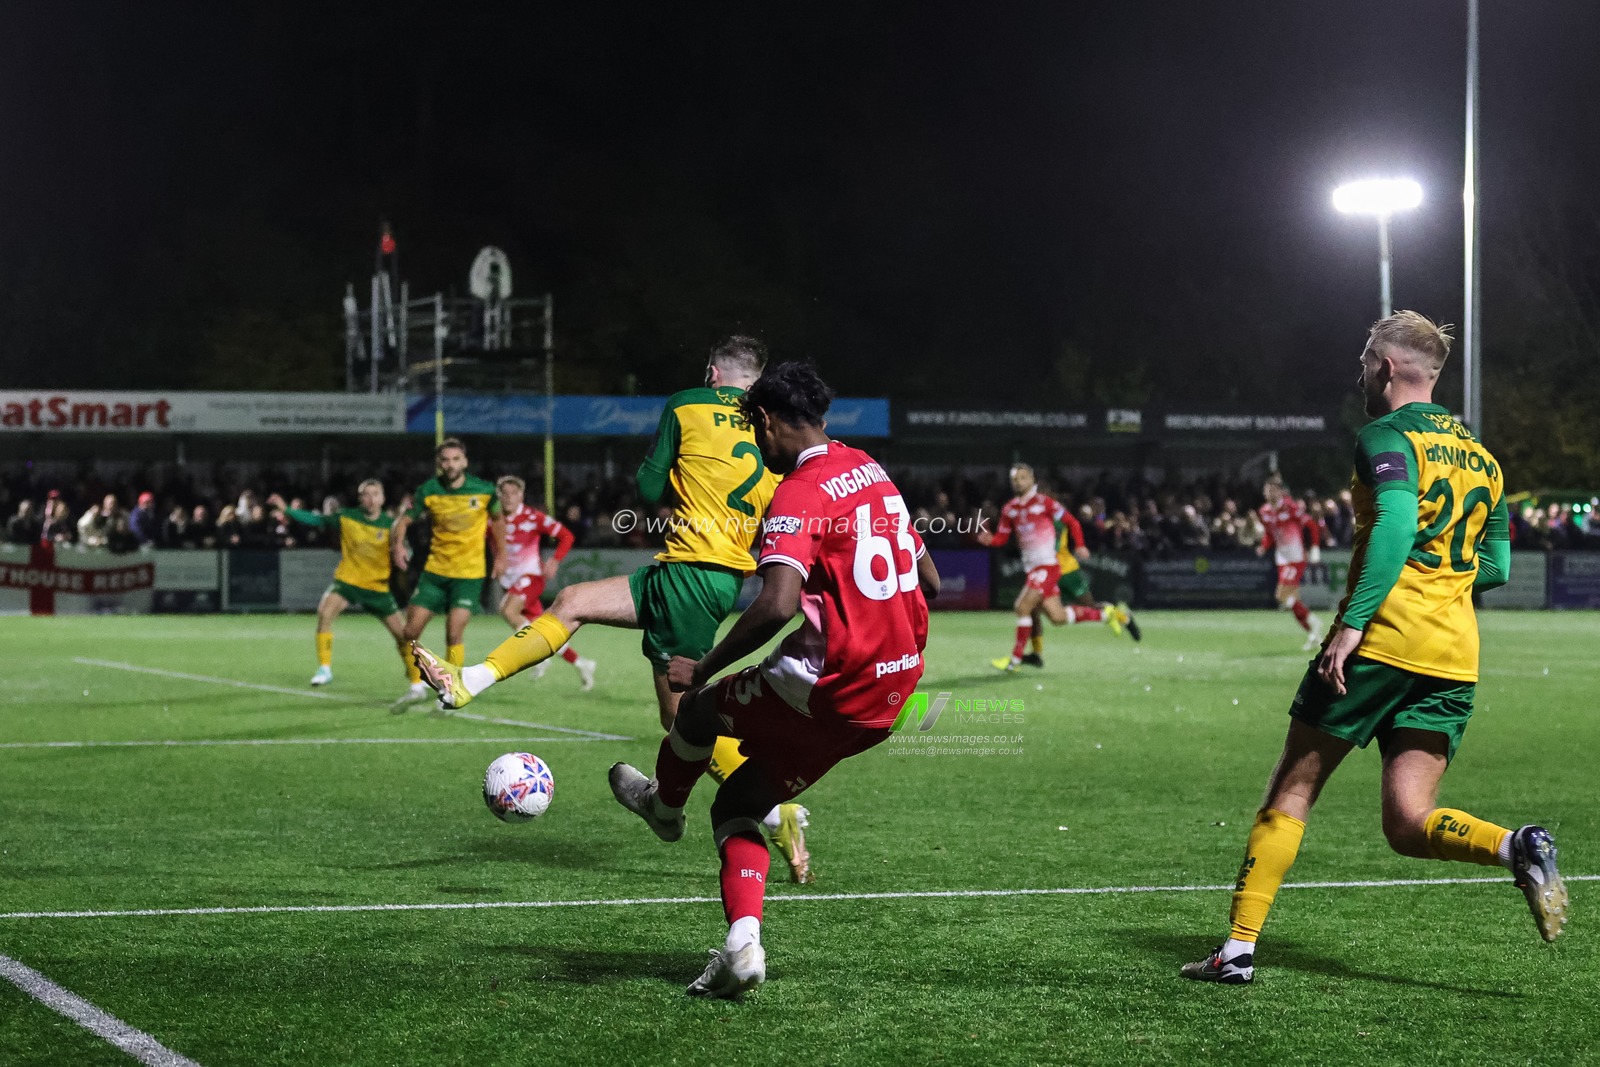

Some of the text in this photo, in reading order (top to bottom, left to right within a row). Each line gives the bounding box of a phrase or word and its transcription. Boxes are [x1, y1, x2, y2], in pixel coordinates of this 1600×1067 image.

[727, 441, 764, 517] 2
[853, 495, 919, 600] 63
[1408, 478, 1492, 572] 20
[741, 869, 763, 883] BFC
